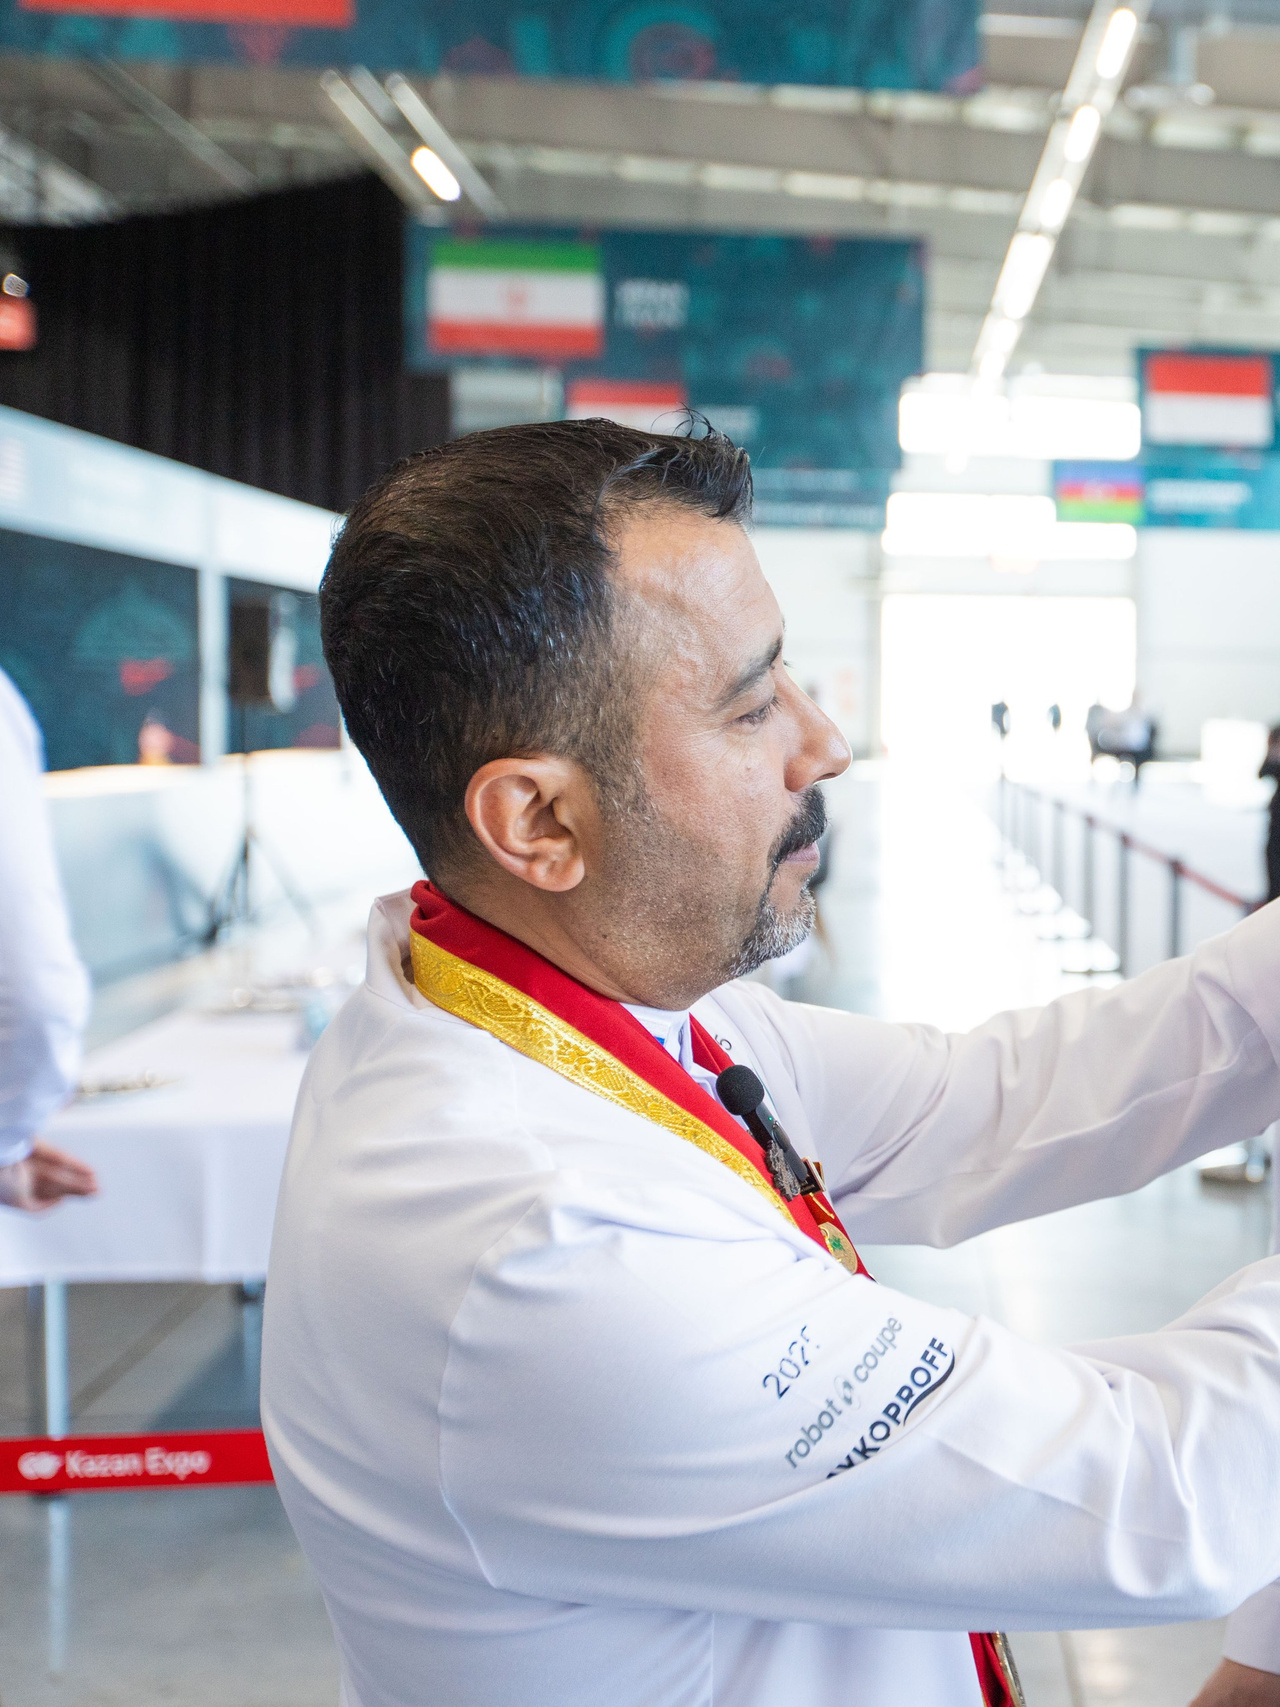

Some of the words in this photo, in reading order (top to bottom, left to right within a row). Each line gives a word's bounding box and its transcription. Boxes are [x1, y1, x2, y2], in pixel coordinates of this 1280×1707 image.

[65, 1450, 144, 1479] Kazan
[145, 1446, 212, 1481] Expo
[784, 1398, 843, 1469] robot
[853, 1317, 902, 1383] coupe
[826, 1337, 948, 1480] YKOPROFF
